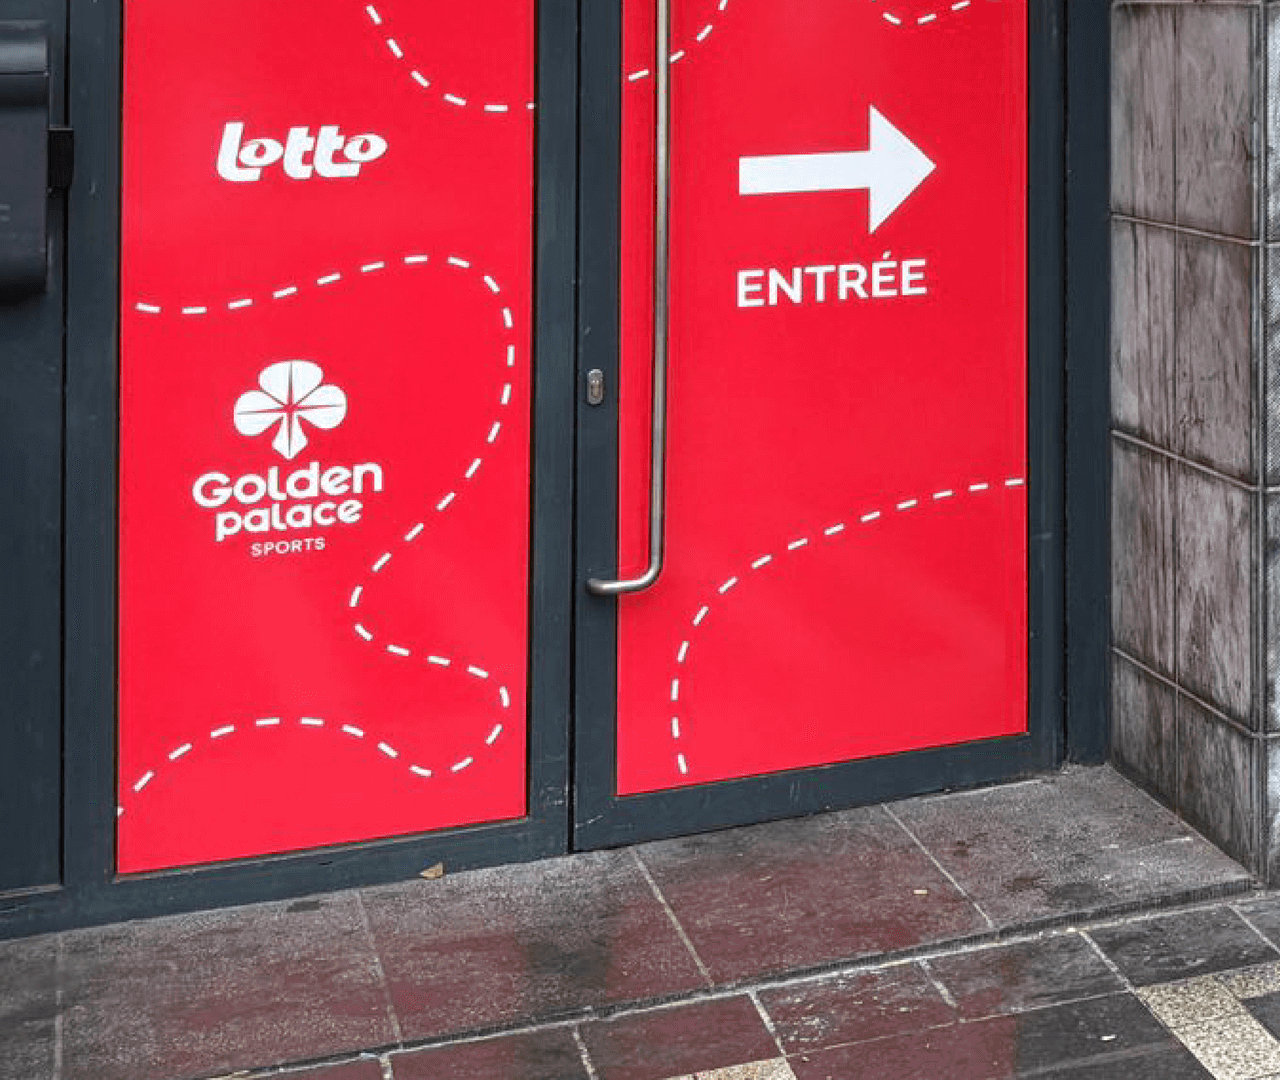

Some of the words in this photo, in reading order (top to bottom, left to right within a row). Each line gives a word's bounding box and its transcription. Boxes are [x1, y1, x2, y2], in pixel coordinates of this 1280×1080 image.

[736, 250, 928, 308] ENTRÉE
[192, 461, 384, 508] Golden
[214, 500, 364, 542] palace
[250, 537, 326, 557] SPORTS
